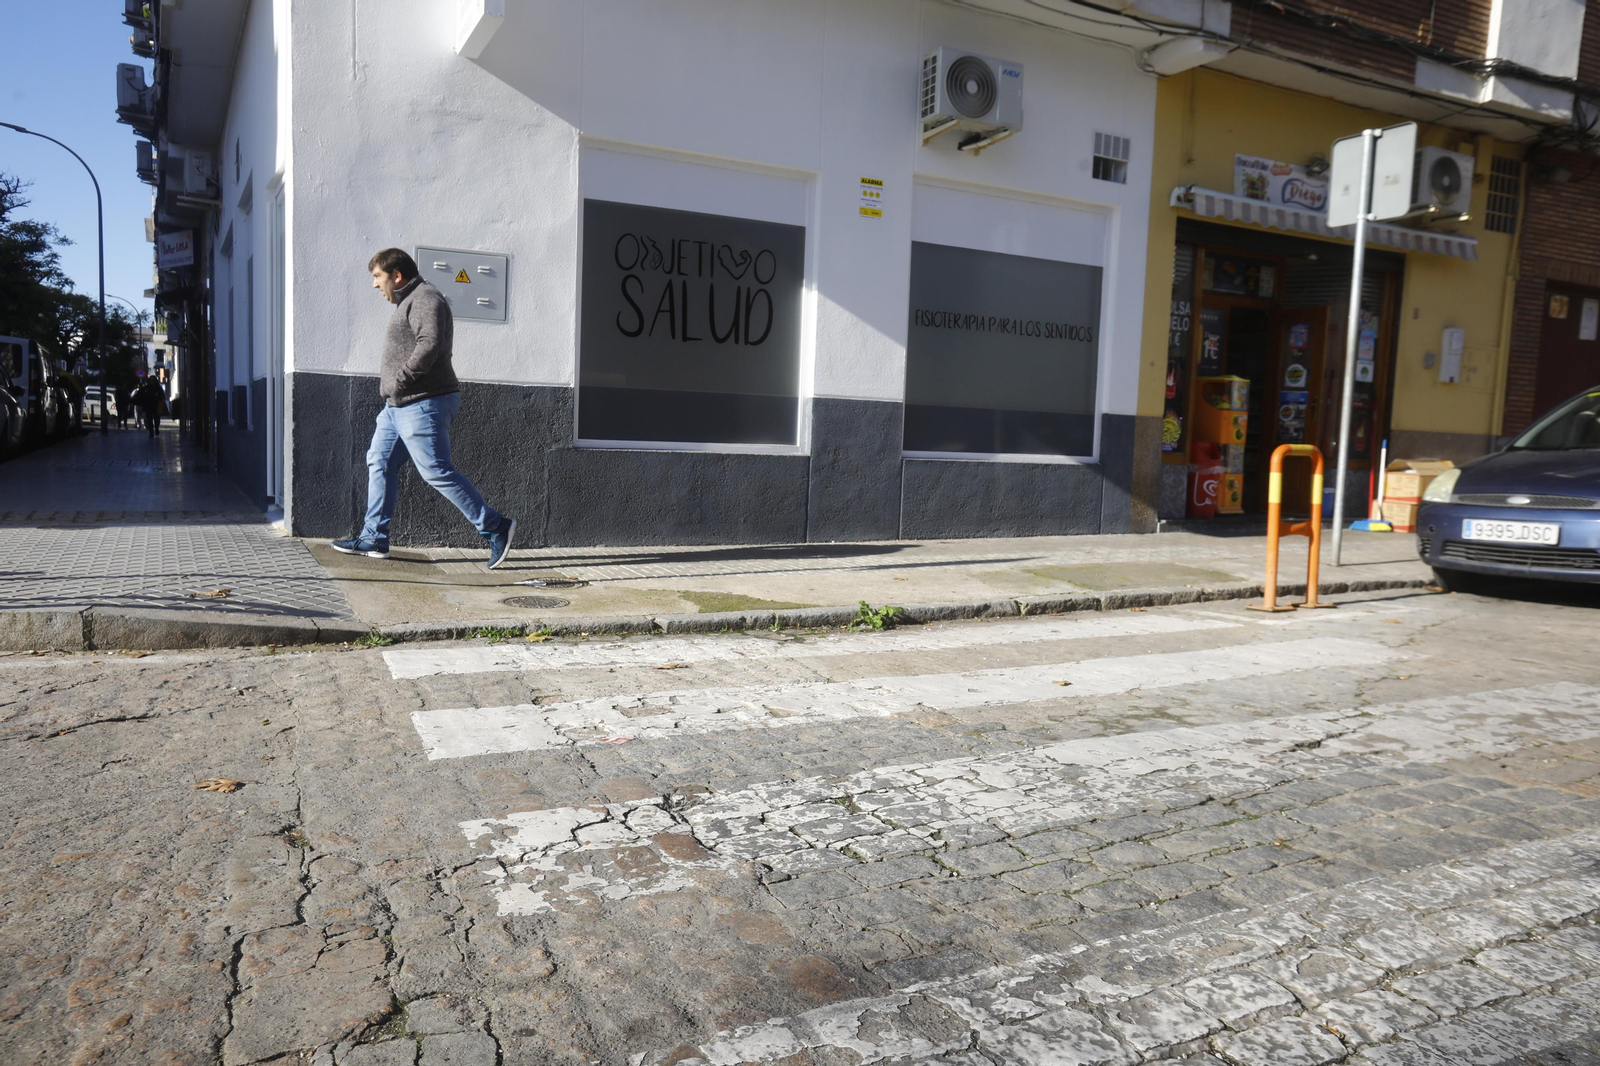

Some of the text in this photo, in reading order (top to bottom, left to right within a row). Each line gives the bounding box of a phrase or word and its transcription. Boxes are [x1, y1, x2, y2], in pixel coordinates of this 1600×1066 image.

[861, 178, 883, 186] ALARMA
[1286, 182, 1323, 207] Diego
[616, 274, 774, 346] SALUD
[915, 309, 1093, 342] FISIOTERAPIA PARA LOS SENTIDOS
[1475, 523, 1552, 541] 9395 DSC
